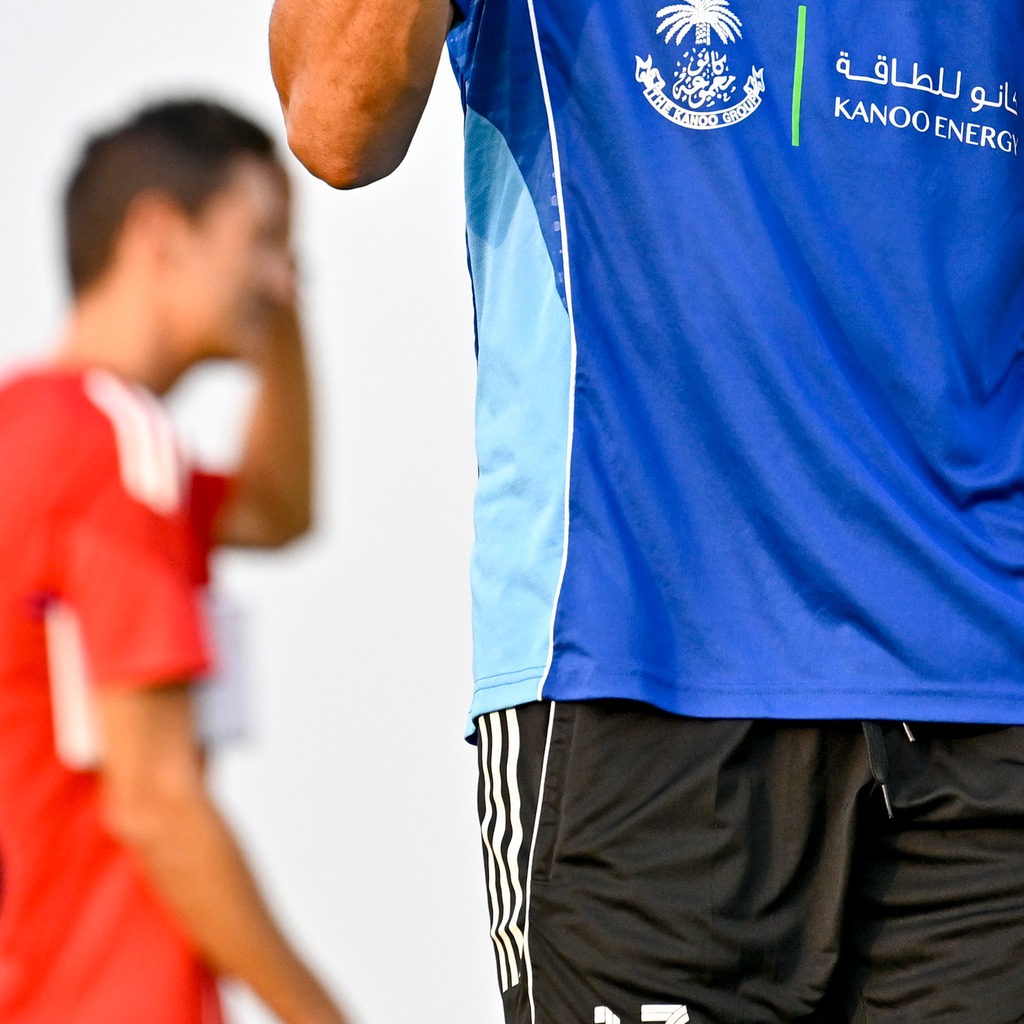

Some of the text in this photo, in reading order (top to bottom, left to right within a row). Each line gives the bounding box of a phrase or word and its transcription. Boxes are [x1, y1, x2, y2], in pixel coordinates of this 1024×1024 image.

[836, 51, 962, 99] للطاقة
[646, 88, 760, 126] THE KANOO GROUP
[834, 96, 1019, 156] KANOO ENERGY
